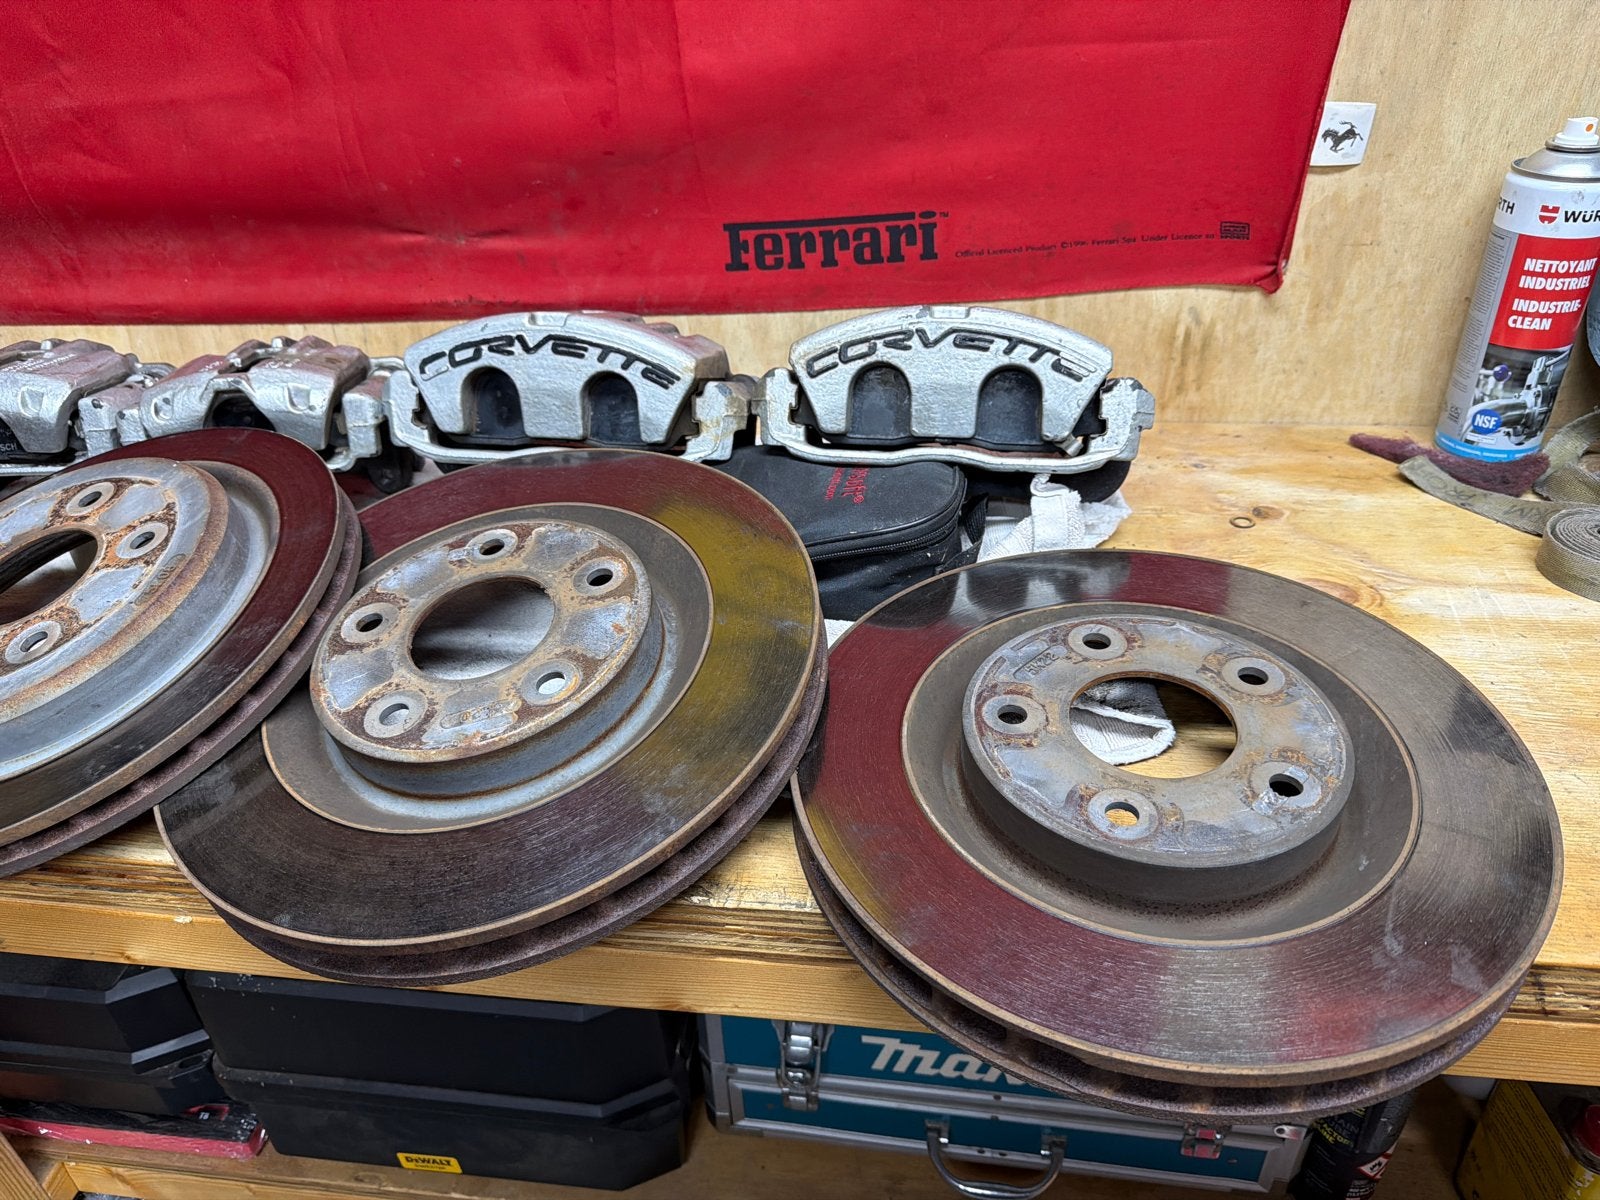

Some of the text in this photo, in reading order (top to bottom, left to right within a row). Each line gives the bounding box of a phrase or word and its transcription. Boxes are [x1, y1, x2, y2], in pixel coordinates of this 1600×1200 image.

[1564, 210, 1600, 223] WÜR
[723, 210, 938, 272] Ferrari
[955, 248, 984, 258] Official
[1523, 257, 1598, 274] NETTOYANT
[1518, 275, 1591, 291] INDUSTRIEL
[1512, 298, 1582, 314] INDUSTRIE-
[1507, 315, 1552, 330] CLEAN
[419, 335, 681, 390] CORVETTE
[806, 327, 1097, 382] CORVETTE
[1474, 414, 1498, 429] NSF
[0, 442, 17, 452] SCH
